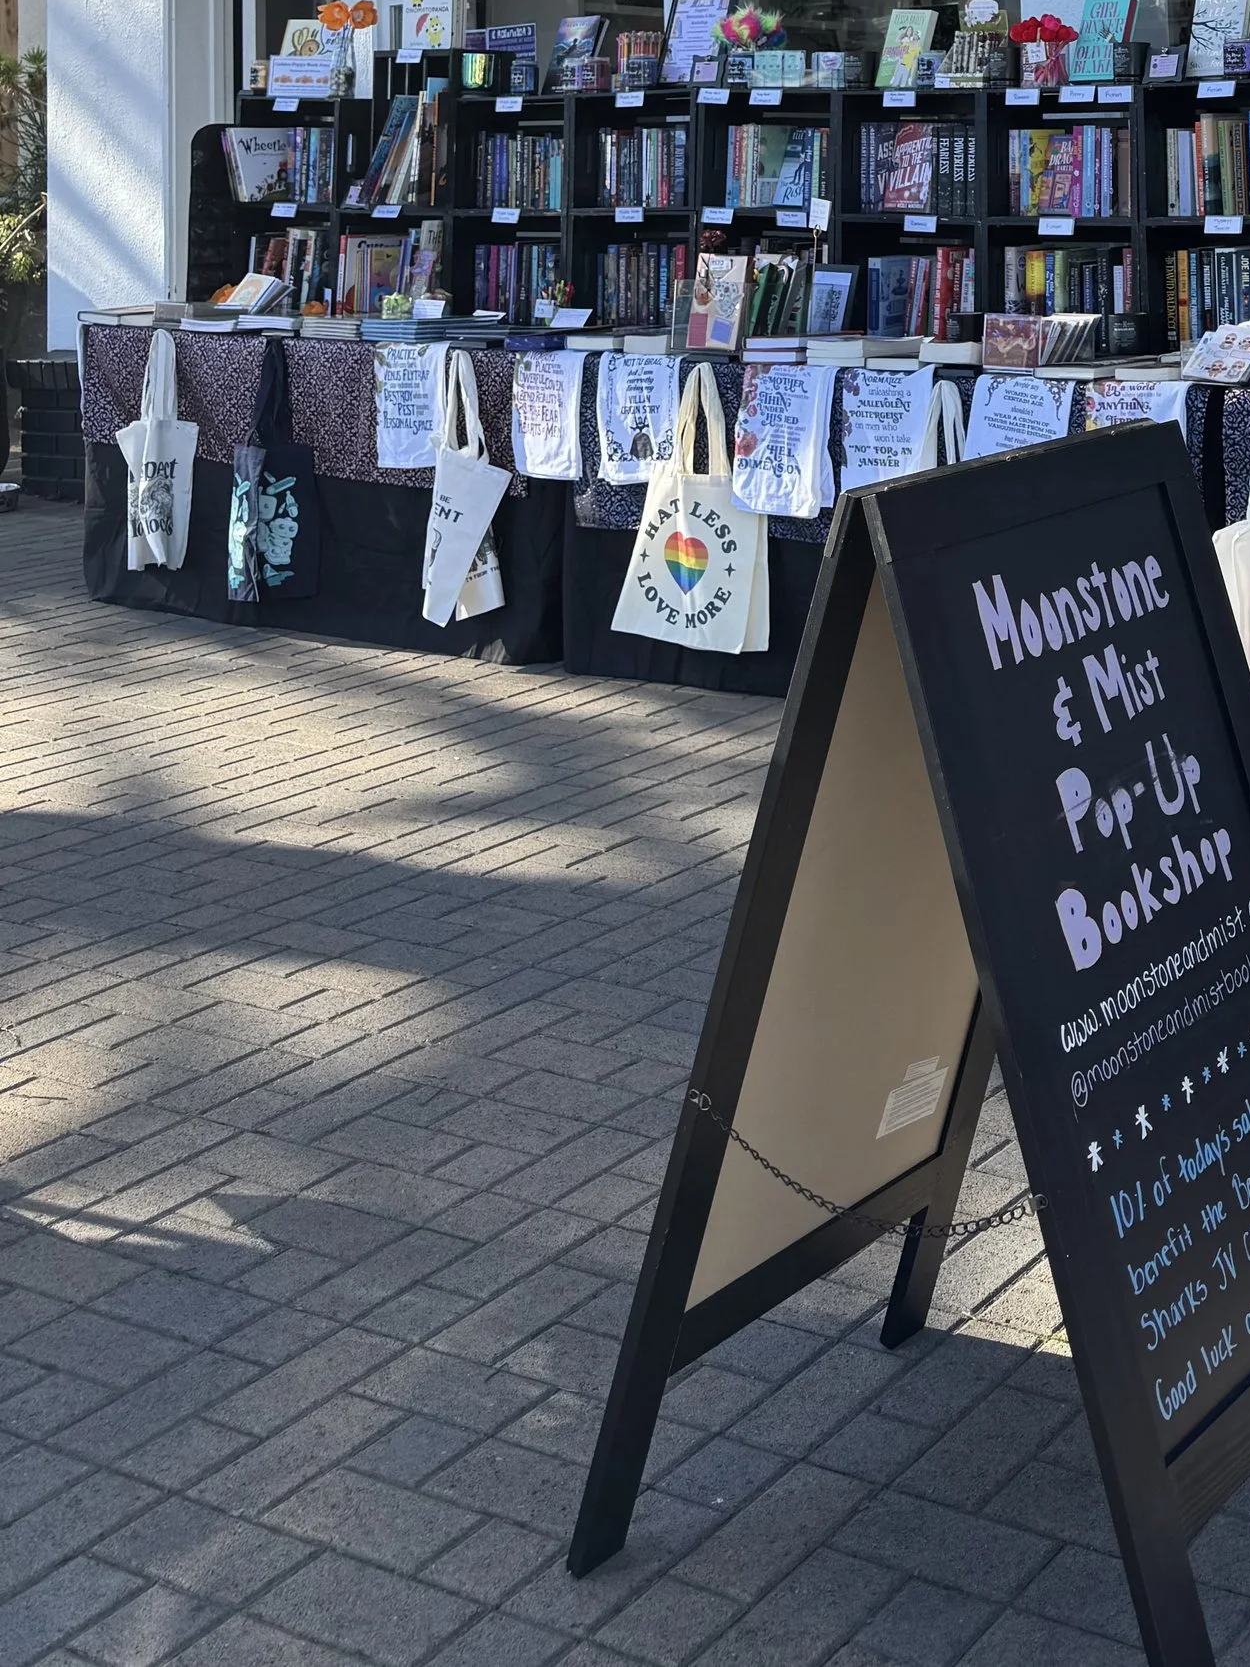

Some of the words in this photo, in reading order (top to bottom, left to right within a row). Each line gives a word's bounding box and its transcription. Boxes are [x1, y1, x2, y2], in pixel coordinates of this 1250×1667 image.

[1090, 2, 1121, 18] GIRL
[1209, 7, 1226, 16] LEE
[940, 138, 949, 174] FEARLESS
[954, 138, 964, 181] POWERLESS
[1241, 255, 1249, 270] JOE
[1241, 272, 1249, 289] HILL
[1167, 291, 1176, 332] BALDACCI
[861, 372, 902, 387] NORMALIZE
[868, 387, 904, 397] unleashing
[1130, 383, 1155, 391] world
[849, 410, 904, 423] POLTERGEIST
[857, 398, 911, 412] MALEVOLENT
[865, 423, 879, 431] men
[882, 422, 897, 431] who
[874, 435, 894, 443] won't
[897, 435, 911, 443] take
[858, 456, 900, 467] ANSWER
[873, 446, 898, 456] FOR
[689, 501, 738, 554] LESS
[638, 574, 679, 625] LOVE
[685, 587, 732, 630] MORE
[972, 555, 1170, 670] Moonstone
[1053, 676, 1081, 746] &
[1082, 643, 1165, 733] Mist
[1056, 733, 1200, 854] Pop-Up
[1055, 828, 1232, 972] Bookshop
[1110, 1186, 1147, 1238] 10%
[1154, 1158, 1172, 1207] of
[1177, 1124, 1230, 1183] today's
[1128, 1217, 1193, 1295] benefit
[1200, 1197, 1226, 1237] the
[1140, 1280, 1208, 1351] Sharks
[1211, 1243, 1238, 1291] JV
[1155, 1369, 1197, 1422] Good
[1200, 1329, 1238, 1376] luck
